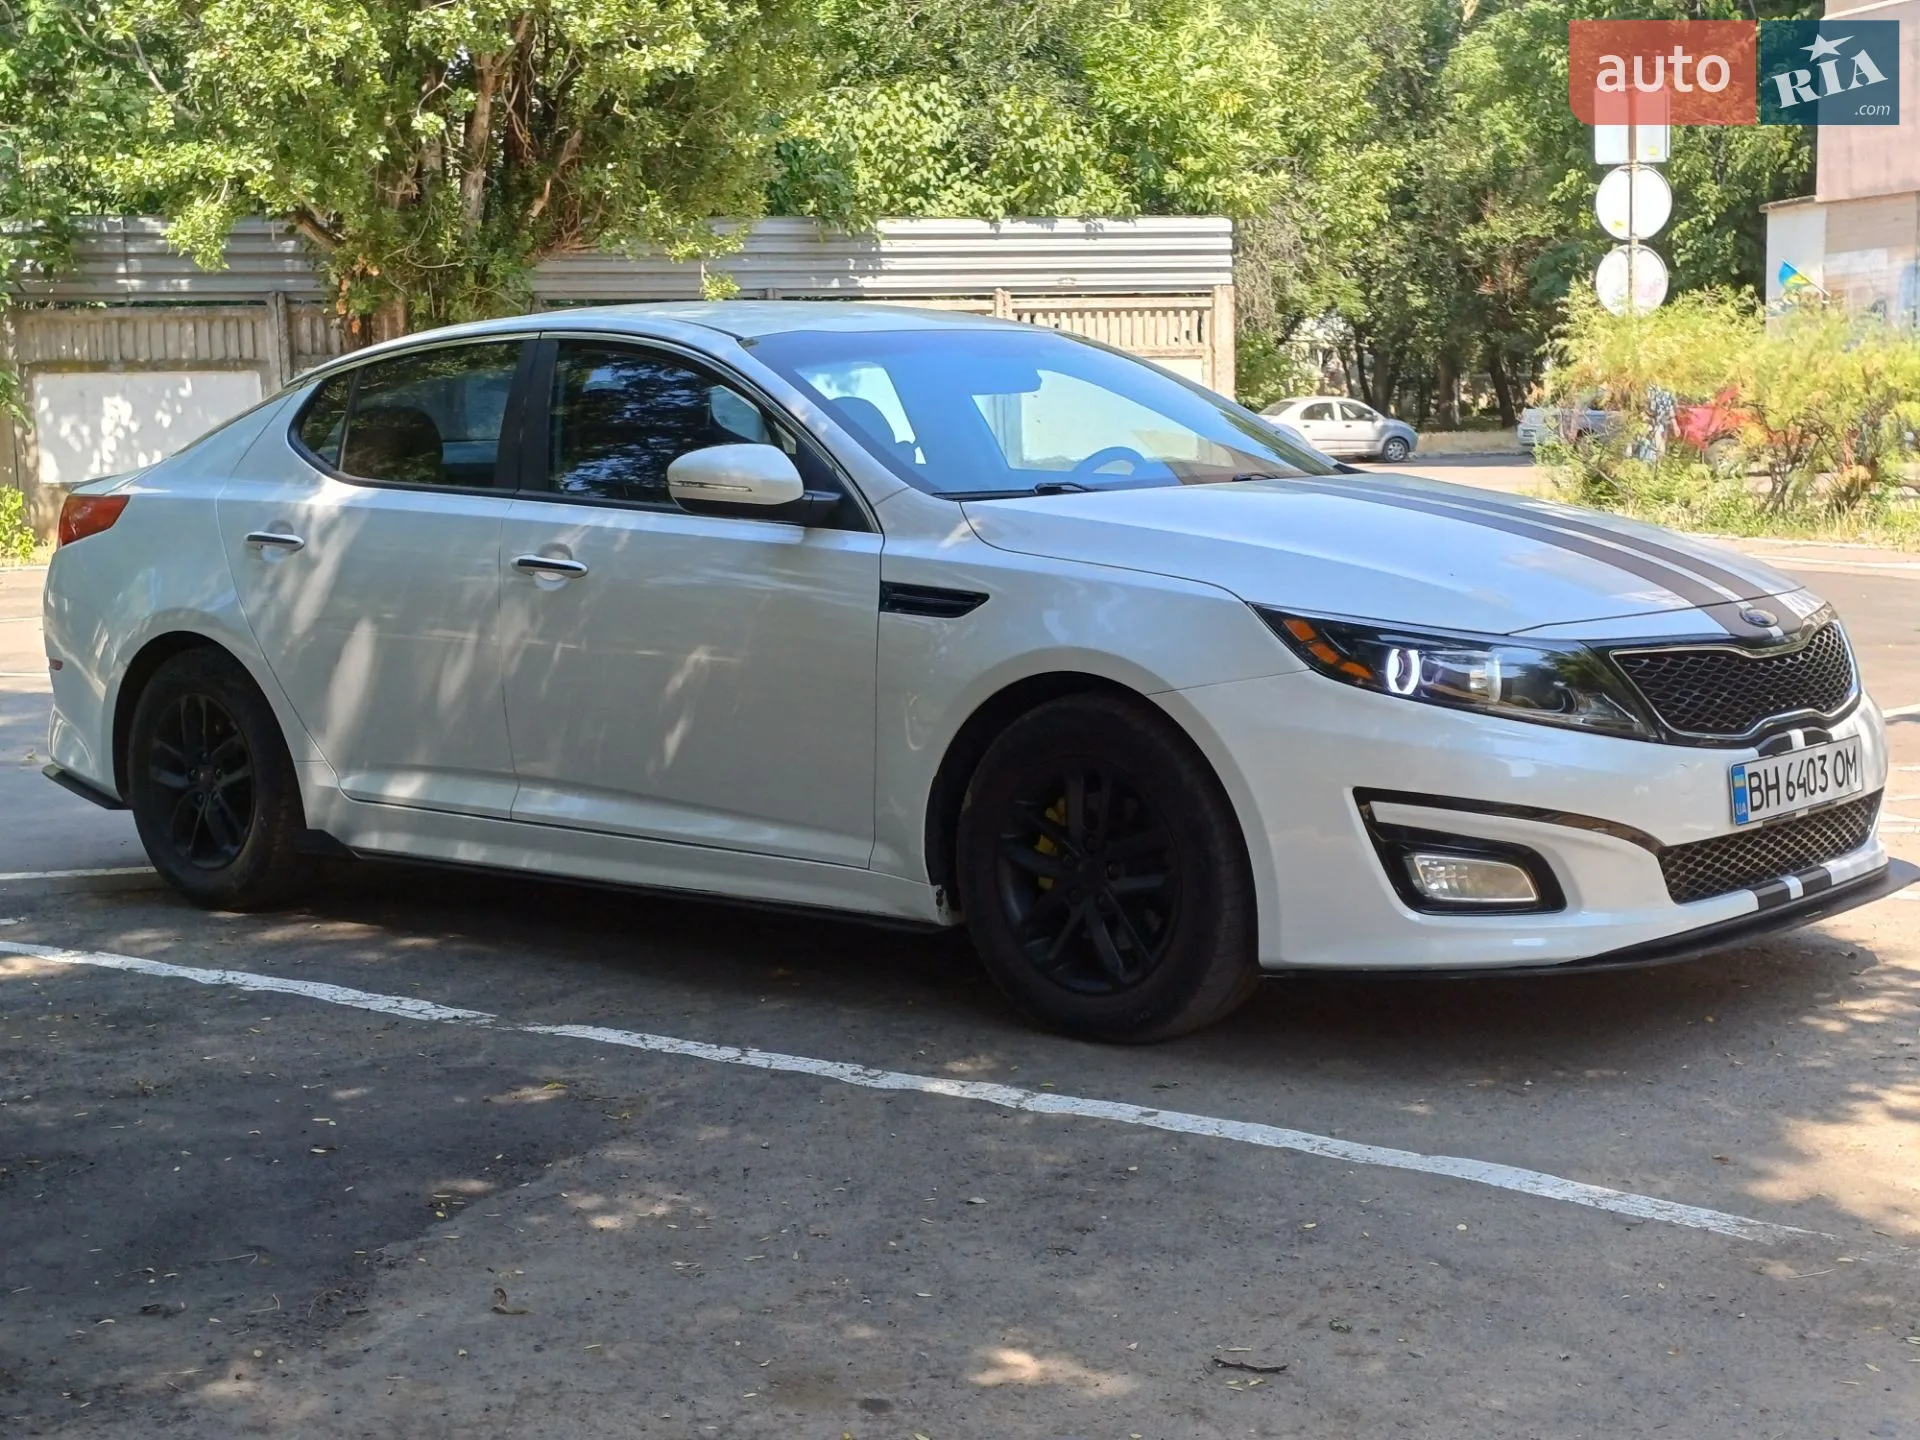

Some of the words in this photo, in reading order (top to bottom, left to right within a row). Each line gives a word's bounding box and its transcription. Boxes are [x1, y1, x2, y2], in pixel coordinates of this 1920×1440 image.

[1748, 766, 1780, 812] BH
[1786, 754, 1829, 802] 6403
[1833, 745, 1857, 788] OM
[1736, 802, 1747, 815] UA
